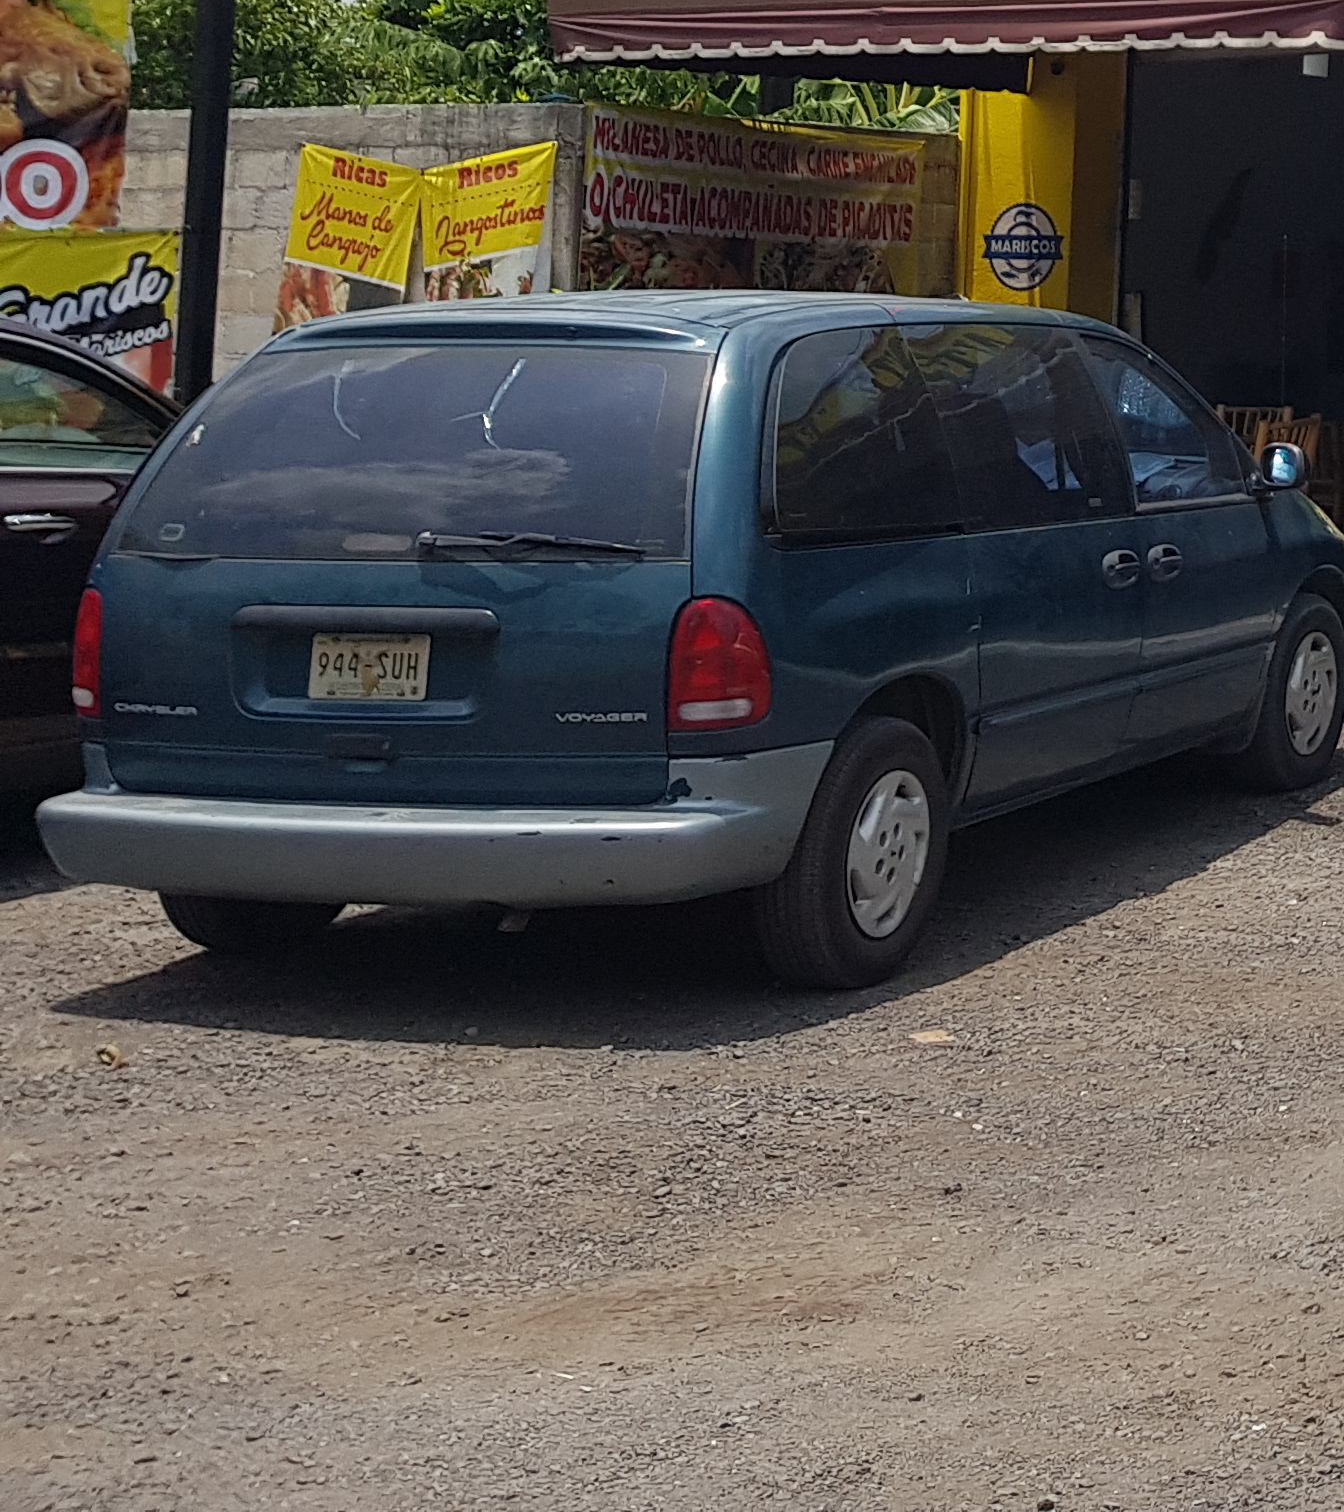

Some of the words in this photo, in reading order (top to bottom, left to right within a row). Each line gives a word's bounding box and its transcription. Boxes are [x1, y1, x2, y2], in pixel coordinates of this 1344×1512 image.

[593, 115, 670, 159] MILANESA
[674, 127, 695, 163] DE
[807, 146, 851, 179] CARNE
[332, 157, 389, 188] Ricas
[457, 159, 519, 189] Ricos
[300, 190, 368, 227] Manos
[372, 205, 395, 233] de
[435, 198, 547, 257] Langostinos
[818, 198, 839, 238] DE
[306, 220, 382, 272] Cangrejo
[990, 239, 1056, 254] MARISCOS
[318, 651, 420, 681] 944-SUH
[555, 712, 648, 723] VOYAGER
